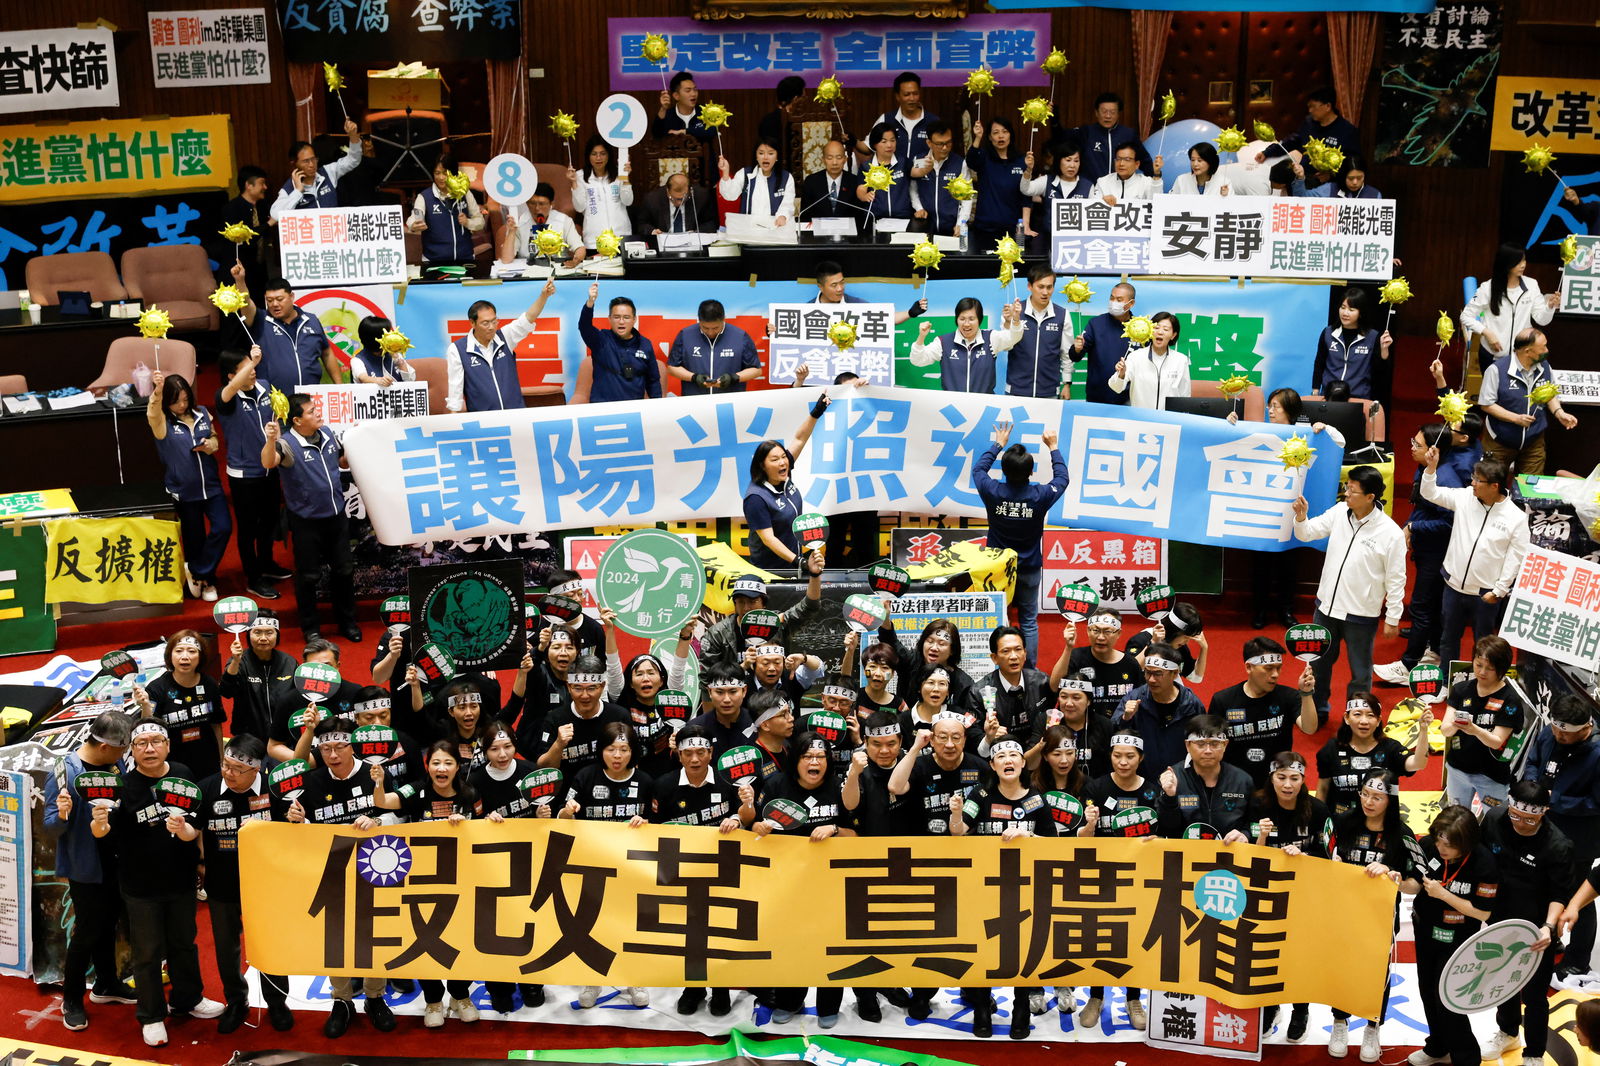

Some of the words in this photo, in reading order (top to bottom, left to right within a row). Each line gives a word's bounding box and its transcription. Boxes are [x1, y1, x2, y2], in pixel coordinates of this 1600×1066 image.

[151, 18, 174, 46] 調查
[178, 15, 266, 45] 圖利im.B詐騙集團
[1399, 28, 1489, 49] 不是民主
[621, 32, 822, 73] 堅定改革
[832, 29, 1036, 71] 全面查弊
[157, 49, 266, 79] 民進黨怕什麼?
[608, 101, 634, 139] 2
[1511, 90, 1600, 140] 改革
[0, 129, 212, 187] 進黨怕什麼
[496, 160, 522, 198] 8
[281, 213, 315, 245] 調查
[319, 206, 404, 243] 圖利綠能光電
[1272, 204, 1305, 233] 調查
[1309, 205, 1394, 236] 圖利綠能光電
[1161, 211, 1264, 262] 安靜
[285, 246, 404, 281] 民進黨怕什麼?
[1270, 241, 1390, 272] 民進黨怕什麼?
[1564, 280, 1600, 312] 民
[395, 395, 1308, 544] 讓陽光照進國會
[995, 505, 1034, 520] 洪孟楷
[796, 517, 825, 531] 沈伯洋
[803, 528, 824, 542] 反對
[52, 535, 178, 584] 反擴權
[1069, 539, 1157, 566] 反黑箱
[606, 571, 640, 585] 2024
[1517, 552, 1568, 599] 調查
[876, 579, 901, 594] 反對
[1063, 598, 1089, 614] 反對
[1146, 597, 1169, 613] 反對
[224, 611, 250, 625] 反對
[389, 611, 411, 623] 反對
[746, 614, 777, 627] 王世堅
[848, 608, 874, 626] 反對
[747, 625, 771, 638] 反對
[1504, 598, 1600, 661] 民進黨怕
[1295, 640, 1321, 652] 反對
[300, 665, 338, 681] 陳俊宇
[303, 680, 331, 693] 反對
[1416, 681, 1437, 694] 反對
[658, 695, 689, 707] 陳冠廷
[292, 709, 327, 726] 王宇
[663, 706, 686, 719] 反對
[361, 742, 388, 755] 反對
[272, 761, 305, 783] 郭國文
[729, 763, 755, 779] 反對
[279, 774, 305, 793] 反對
[531, 782, 555, 799] 反對
[87, 787, 114, 799] 反對
[165, 793, 192, 809] 反對
[314, 803, 344, 821] 反黑箱
[1051, 807, 1073, 825] 反對
[1123, 822, 1151, 838] 反對
[1204, 879, 1237, 916] 眾
[308, 828, 771, 986] 假改革
[826, 844, 1296, 1006] 真擴權
[1452, 961, 1483, 977] 2024
